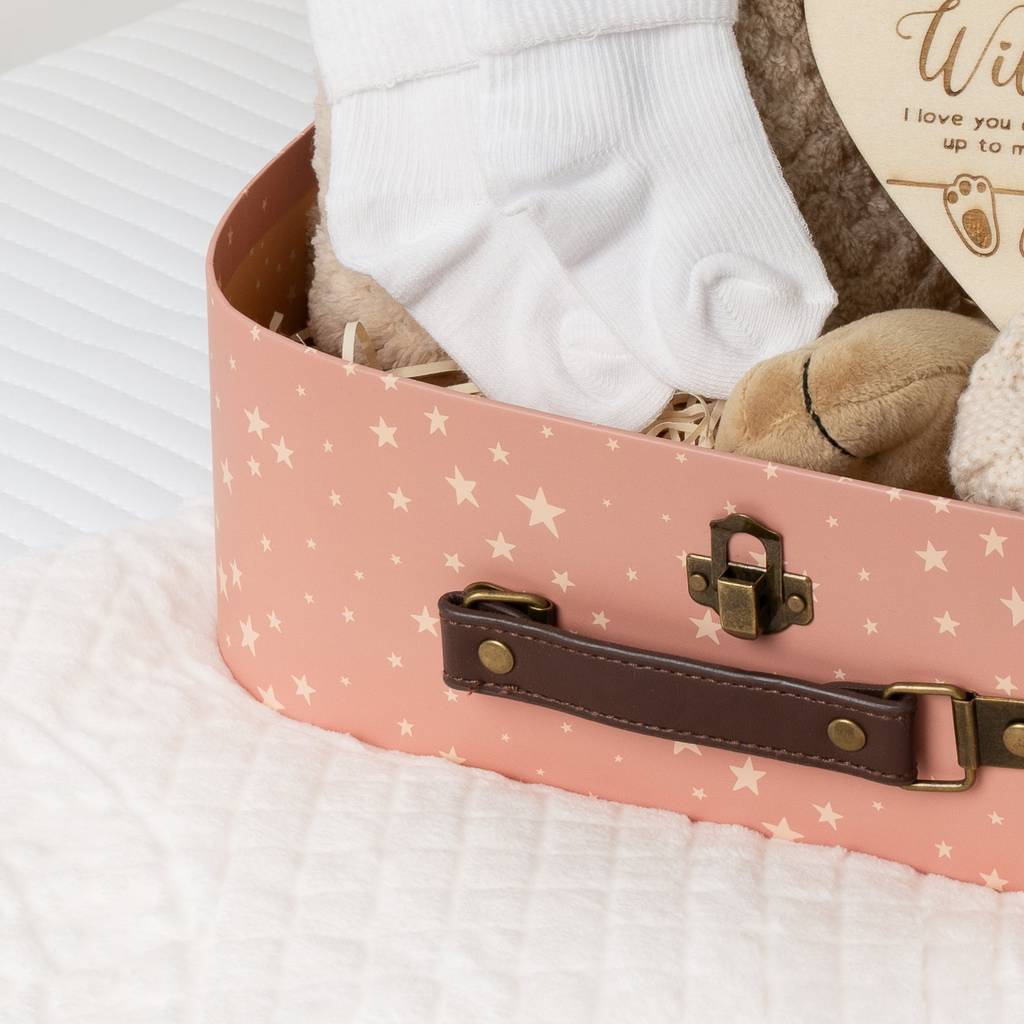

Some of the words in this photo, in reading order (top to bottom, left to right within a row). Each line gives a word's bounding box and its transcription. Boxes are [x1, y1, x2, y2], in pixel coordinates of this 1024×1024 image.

[904, 107, 909, 121] I
[918, 108, 963, 126] love
[974, 116, 1011, 132] you
[944, 137, 967, 154] up
[979, 138, 1001, 154] to
